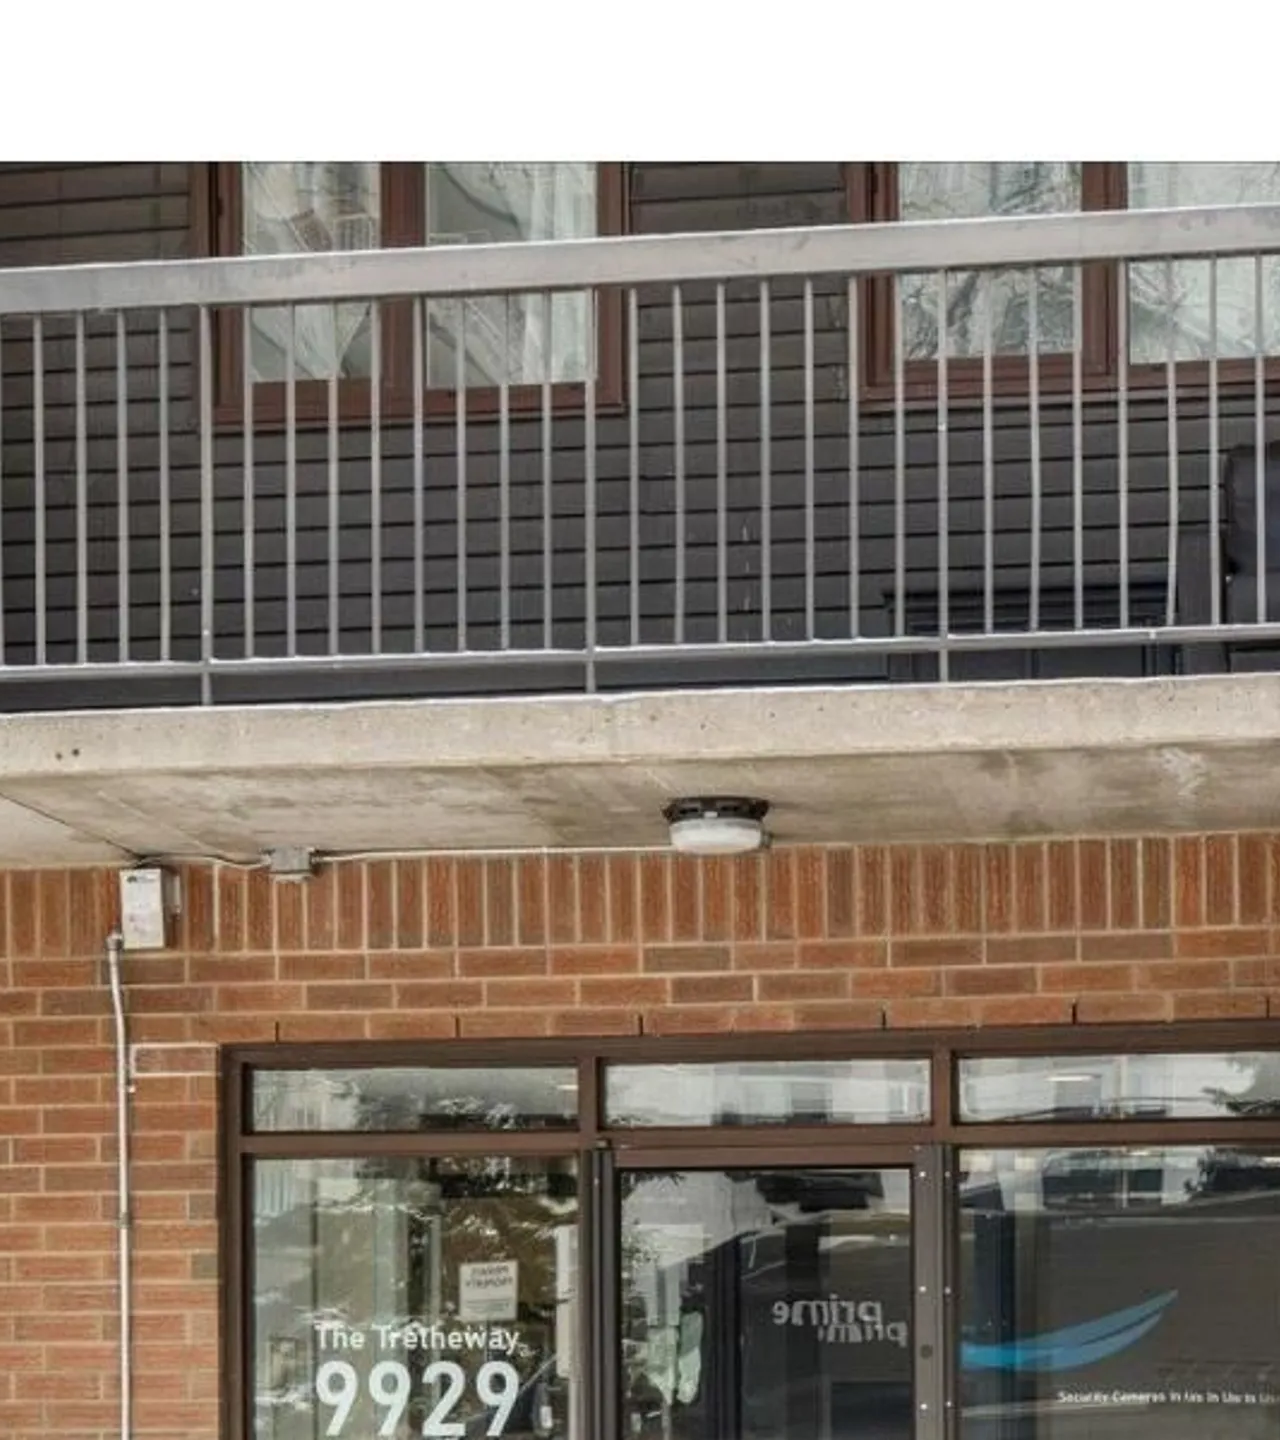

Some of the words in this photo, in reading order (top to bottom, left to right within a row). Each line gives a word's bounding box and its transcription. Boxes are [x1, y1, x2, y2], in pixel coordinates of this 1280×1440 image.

[315, 1325, 365, 1349] The
[372, 1325, 520, 1355] Tretheway
[316, 1360, 519, 1437] 9929
